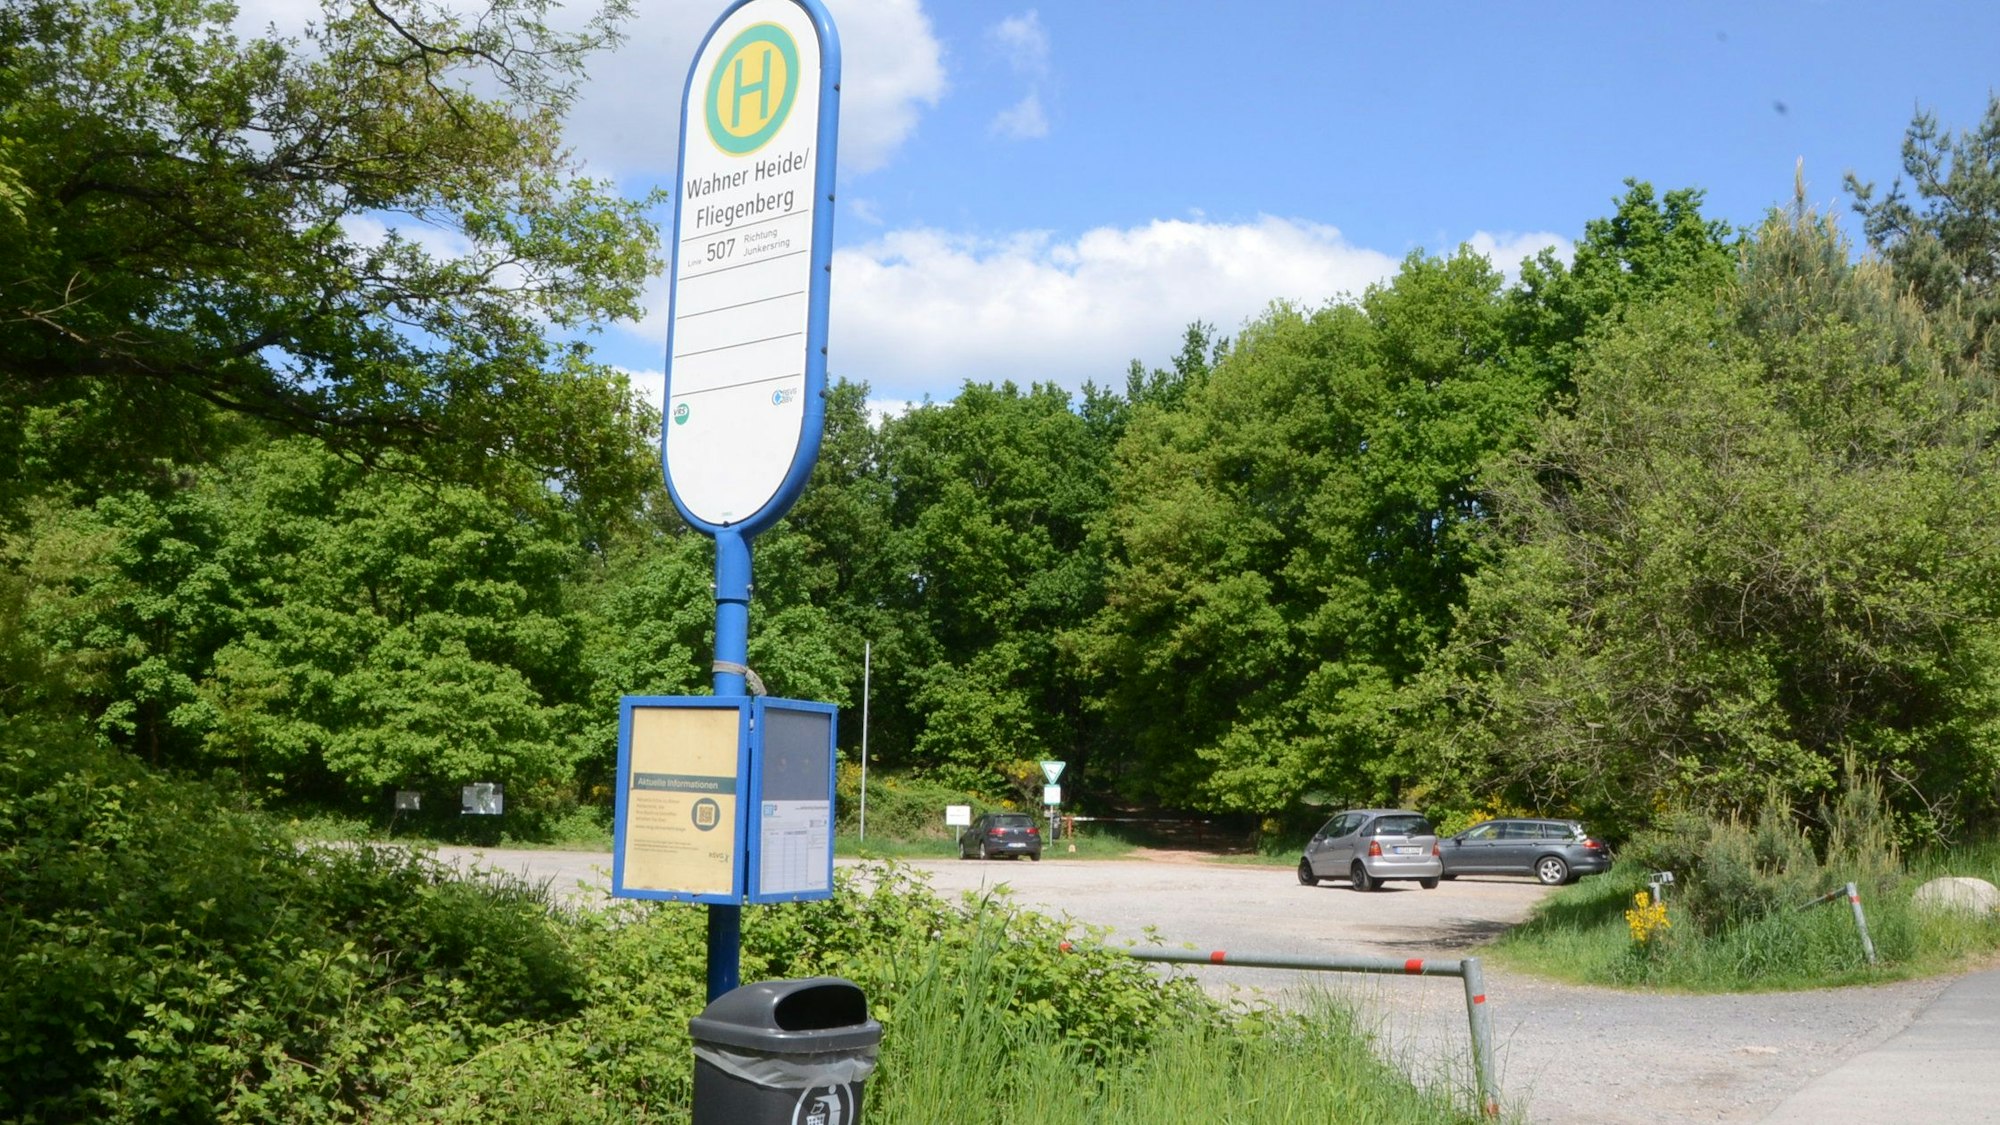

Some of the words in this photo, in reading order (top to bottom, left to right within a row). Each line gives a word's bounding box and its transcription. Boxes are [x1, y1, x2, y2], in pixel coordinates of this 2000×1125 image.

[731, 49, 772, 129] H
[686, 169, 749, 200] Wahner
[754, 147, 810, 183] Heide/
[696, 189, 795, 229] Fliegenberg
[743, 228, 778, 243] Richtung
[706, 237, 736, 262] 507
[743, 238, 791, 257] Junkersring
[673, 407, 686, 417] VRS
[637, 777, 666, 787] Aktuelle
[667, 779, 719, 790] Informationen
